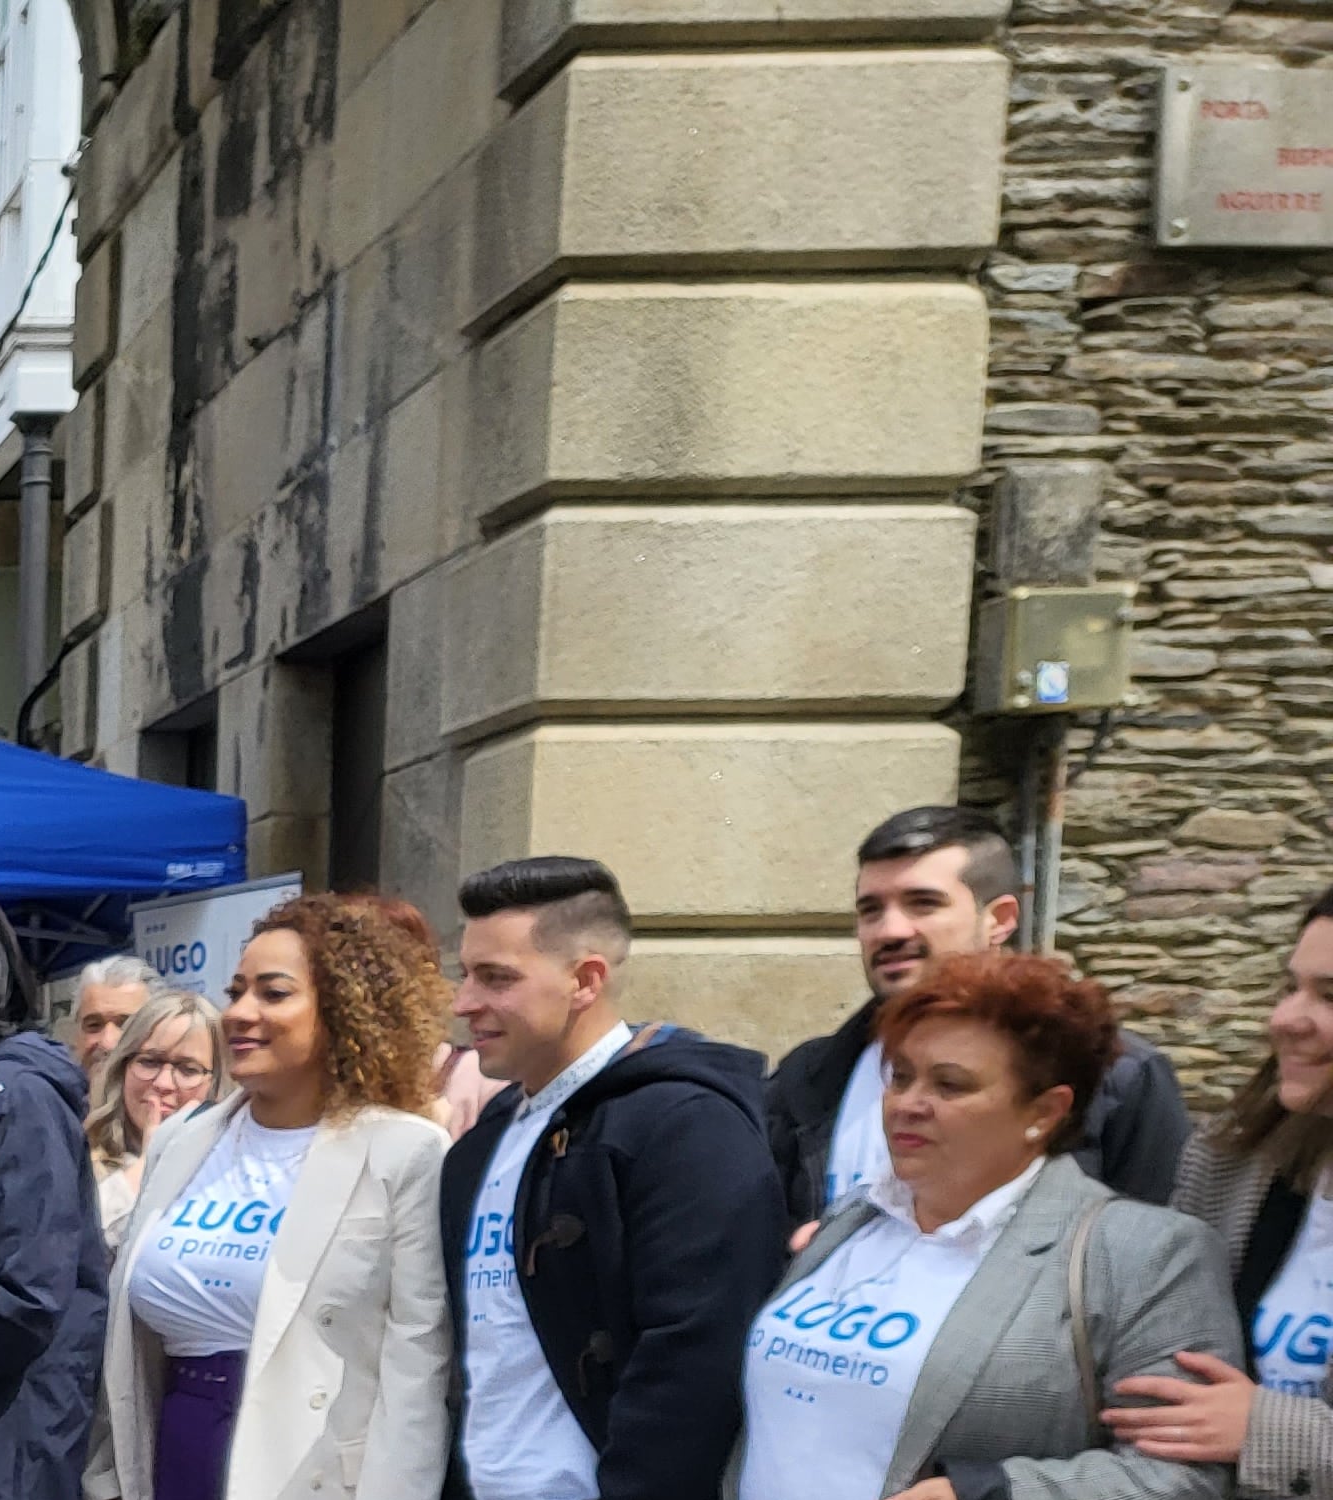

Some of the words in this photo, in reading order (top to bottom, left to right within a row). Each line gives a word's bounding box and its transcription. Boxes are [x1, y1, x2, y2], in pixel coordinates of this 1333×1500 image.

[1217, 191, 1323, 212] AGUIRRE
[177, 1239, 271, 1262] primei
[773, 1286, 919, 1349] LUGO
[764, 1336, 889, 1386] primeiro
